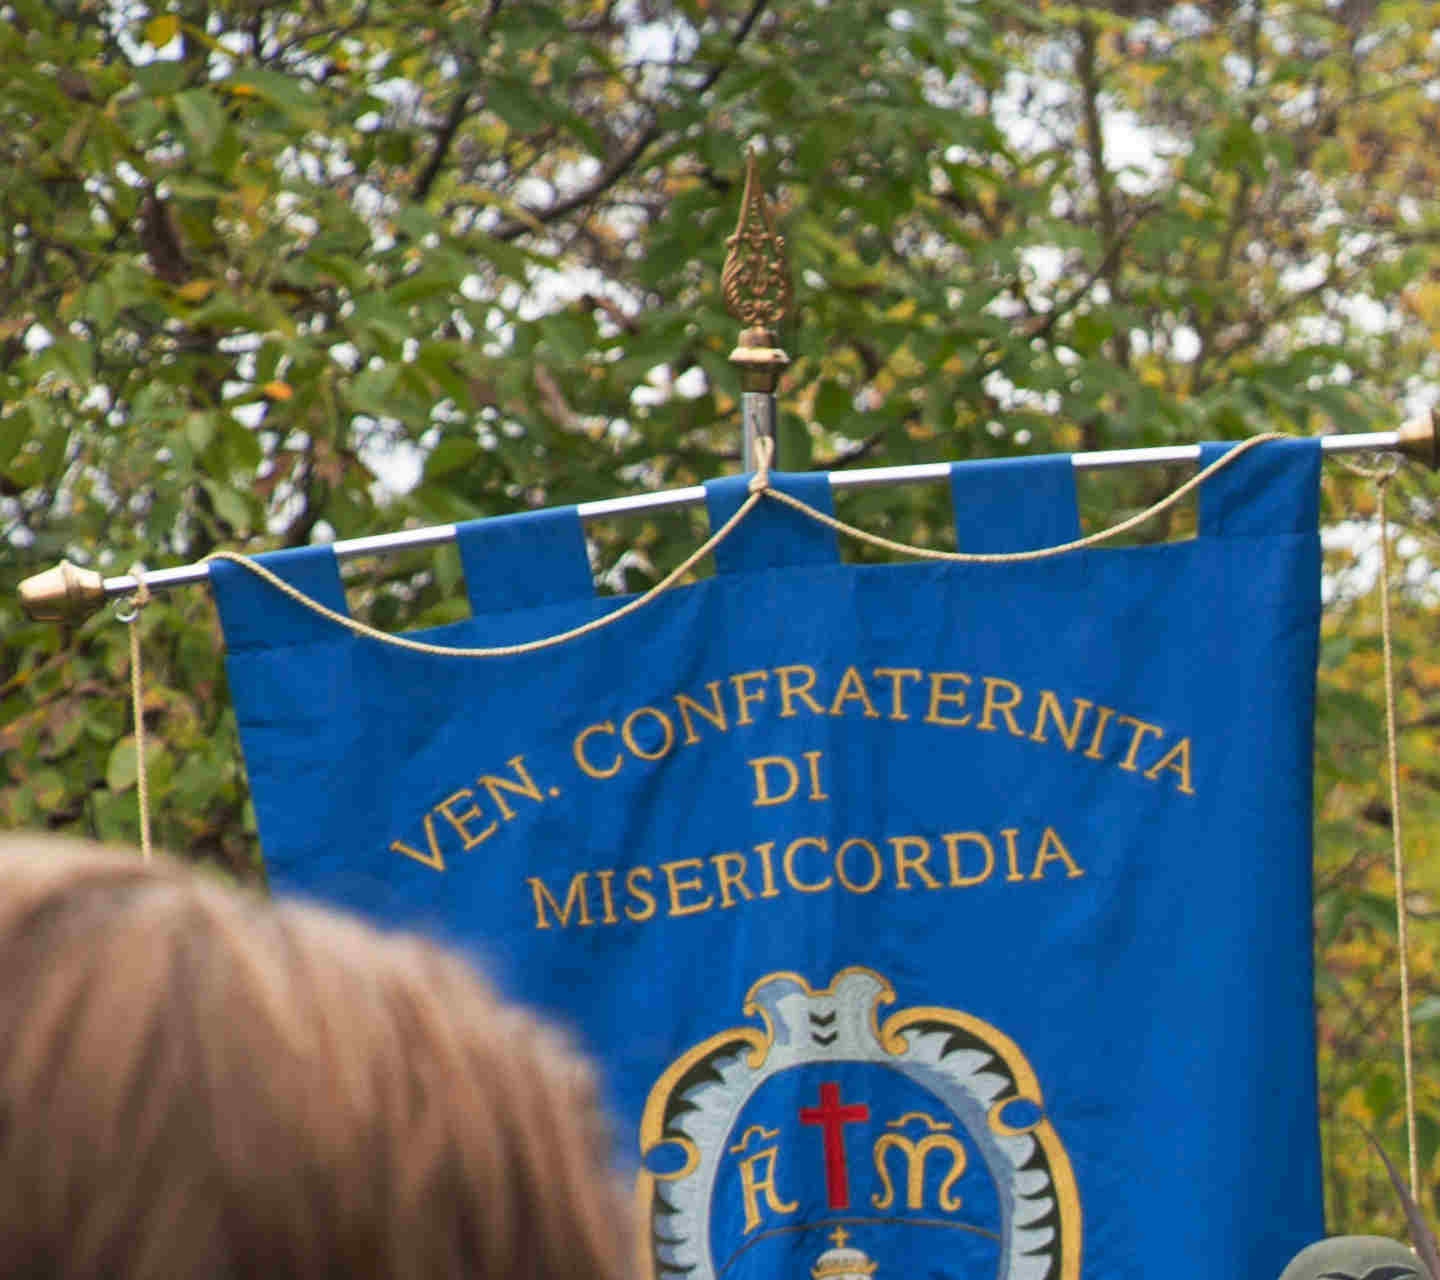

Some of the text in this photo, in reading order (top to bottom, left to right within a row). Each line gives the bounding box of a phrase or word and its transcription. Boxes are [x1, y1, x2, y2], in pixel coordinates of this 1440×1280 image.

[390, 663, 1196, 878] VEN. CONFRATERNITA
[750, 750, 830, 808] DI
[526, 824, 1084, 930] MISERICORDIA
